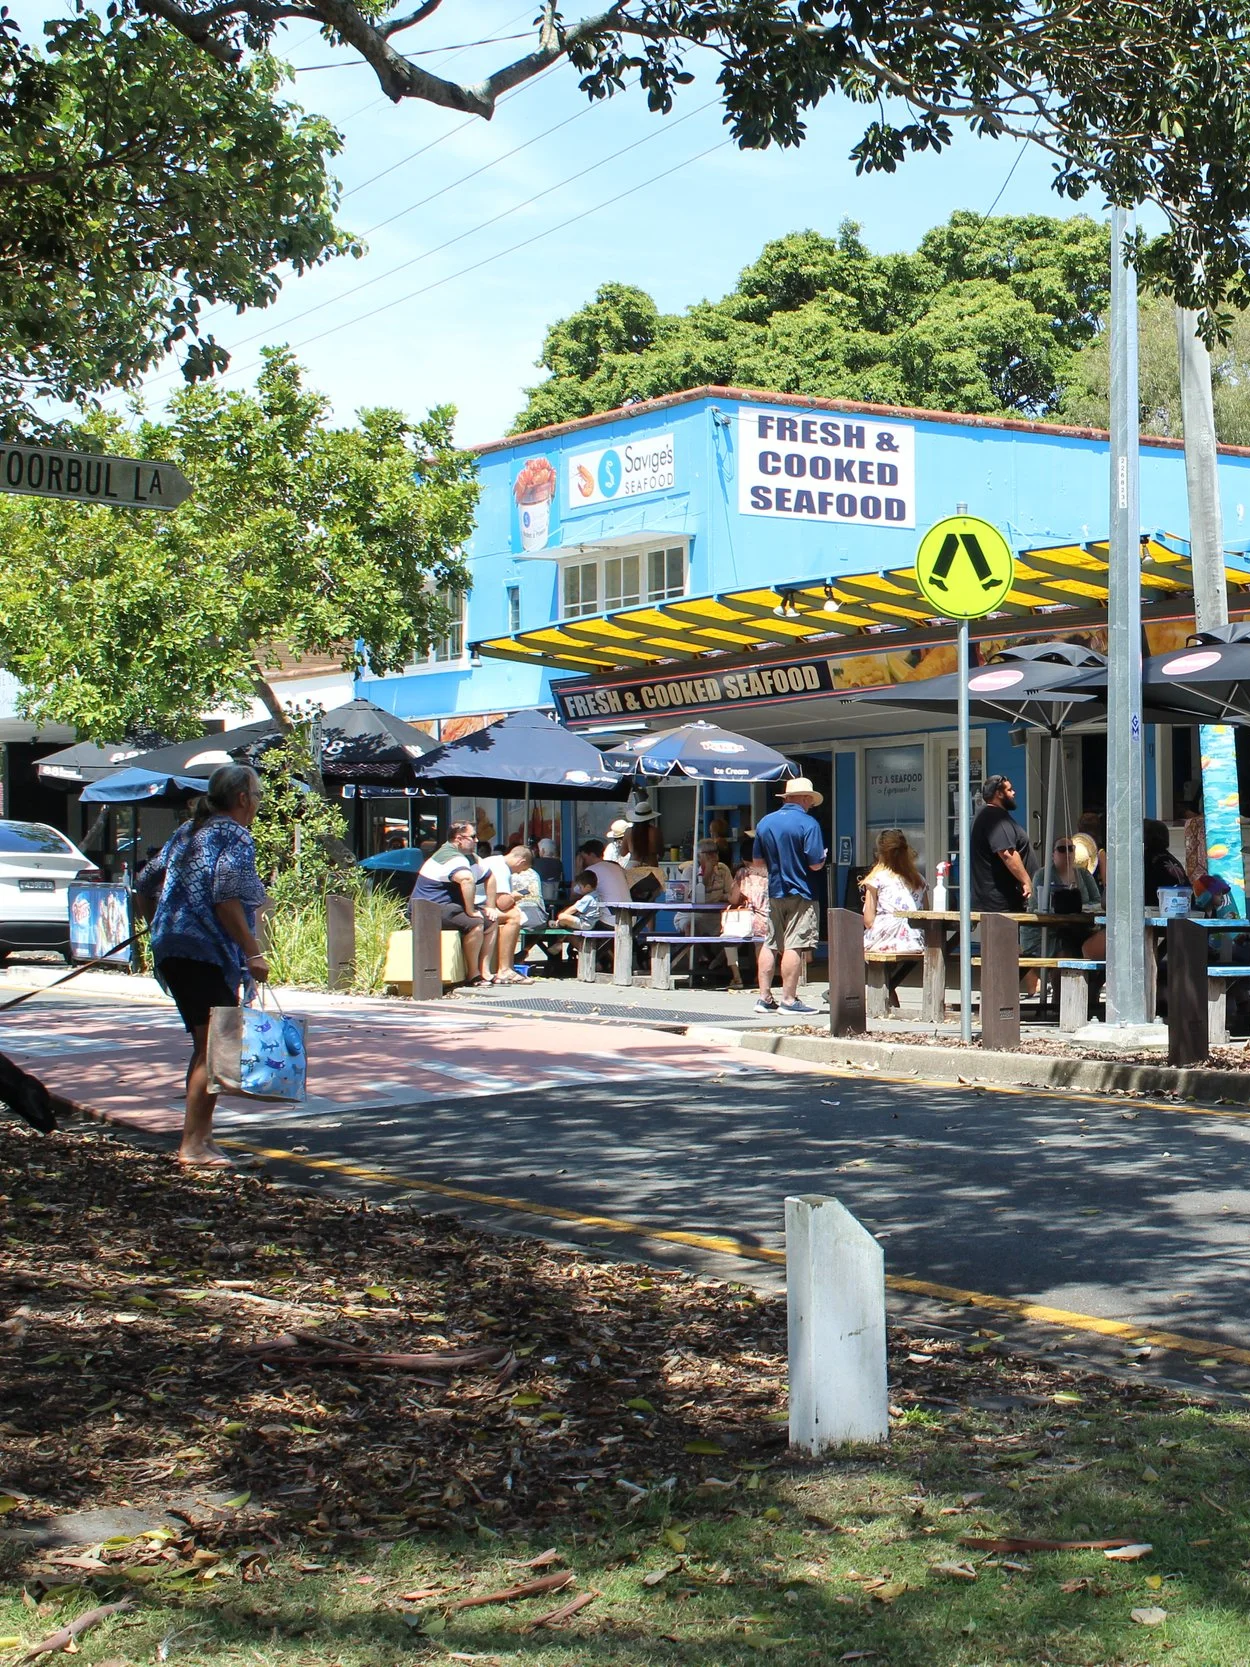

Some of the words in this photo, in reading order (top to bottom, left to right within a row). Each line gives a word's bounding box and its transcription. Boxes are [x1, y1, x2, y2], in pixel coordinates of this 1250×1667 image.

[758, 415, 865, 449] FRESH
[875, 432, 899, 452] &
[625, 443, 673, 473] Savige's
[758, 451, 899, 486] COOKED
[134, 466, 162, 500] LA
[625, 473, 673, 495] SEAFOOD
[750, 485, 906, 521] SEAFOOD
[564, 690, 624, 718] FRESH
[625, 686, 641, 711] &
[641, 677, 721, 709] COOKED
[726, 665, 820, 699] SEAFOOD
[714, 767, 724, 775] Ice
[725, 767, 749, 775] Cream
[891, 773, 922, 783] SEAFOOD
